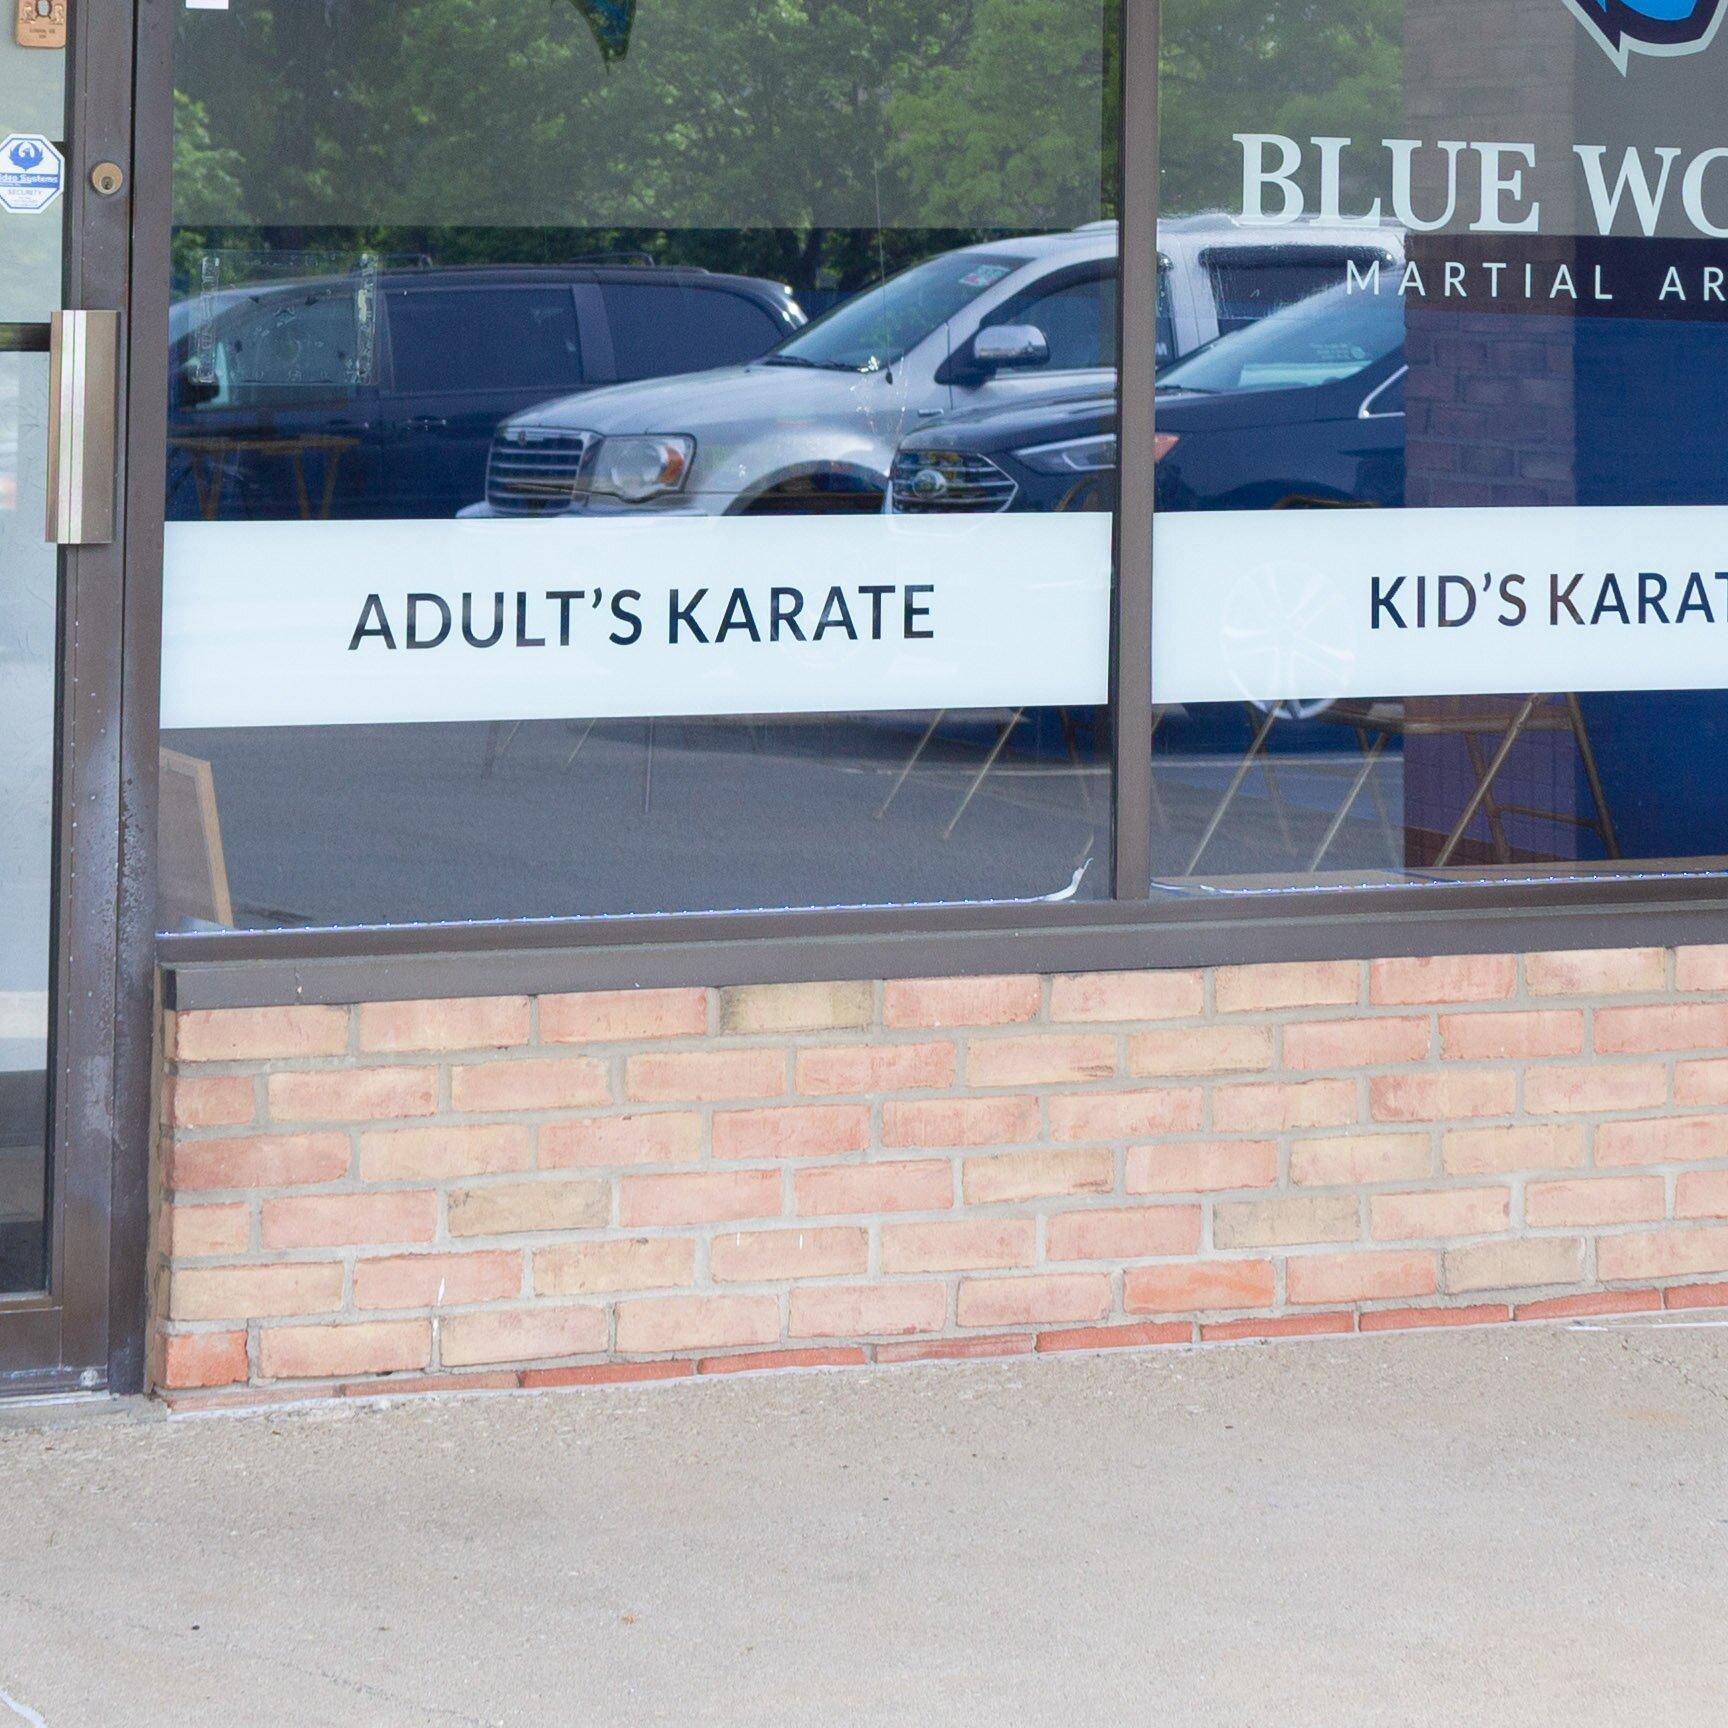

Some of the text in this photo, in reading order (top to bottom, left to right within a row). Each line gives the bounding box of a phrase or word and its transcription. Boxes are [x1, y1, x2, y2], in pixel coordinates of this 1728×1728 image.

[1231, 132, 1540, 234] BLUE
[1345, 261, 1614, 301] MARTIAL
[348, 584, 935, 651] ADULT'S KARATE
[1371, 572, 1528, 630] KID'S
